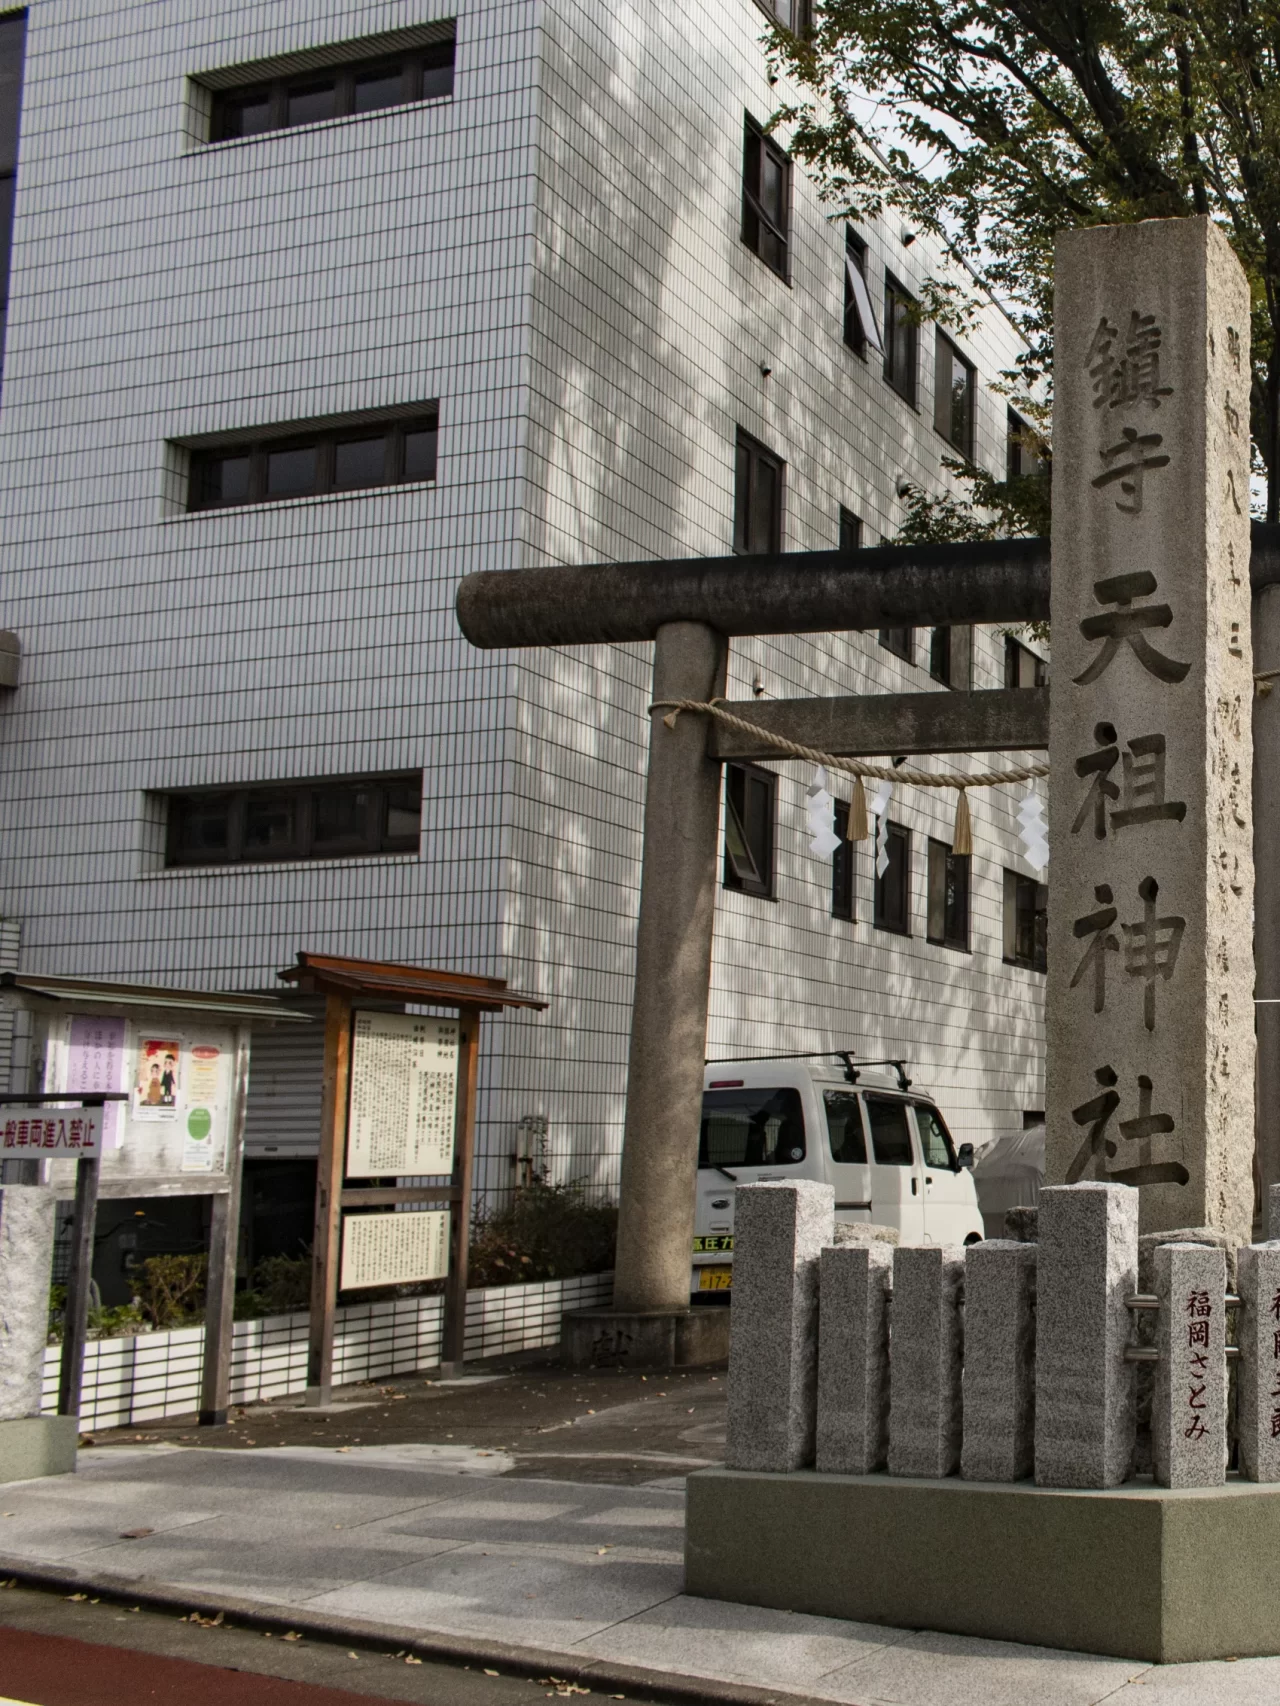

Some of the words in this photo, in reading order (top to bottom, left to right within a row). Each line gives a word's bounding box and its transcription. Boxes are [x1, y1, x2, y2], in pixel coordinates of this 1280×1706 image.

[1184, 1290, 1212, 1440] 福岡さとみ
